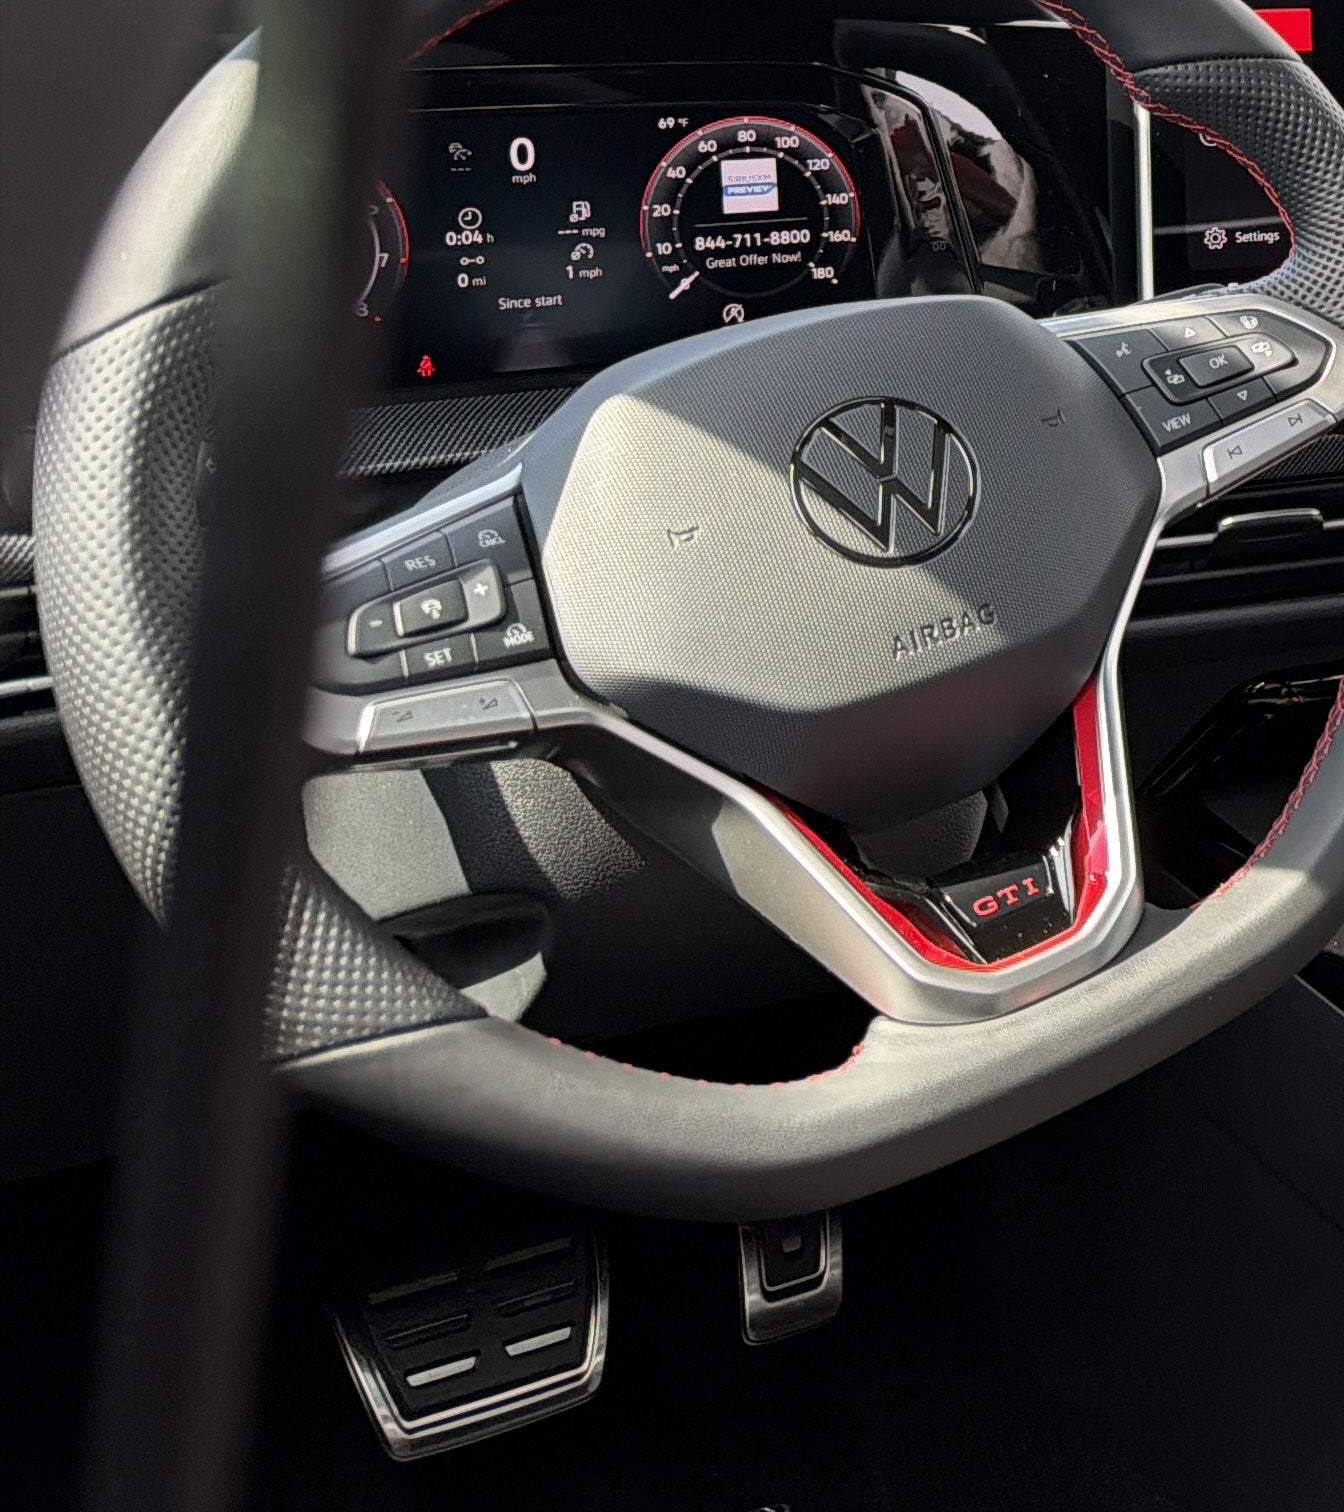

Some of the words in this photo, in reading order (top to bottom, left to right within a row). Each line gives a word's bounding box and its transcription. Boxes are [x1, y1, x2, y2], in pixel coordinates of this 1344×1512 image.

[657, 116, 675, 130] 69
[737, 130, 756, 142] 80
[775, 136, 799, 148] 100
[698, 140, 717, 152] 60
[510, 137, 535, 171] 0
[807, 158, 830, 171] 120
[512, 173, 537, 185] mph
[666, 166, 686, 179] 40
[727, 185, 772, 194] PREVIEW
[825, 192, 849, 205] 140
[652, 204, 671, 217] 20
[445, 230, 484, 246] 0:04
[486, 233, 495, 244] h
[581, 227, 606, 238] mpg
[828, 230, 851, 242] 160
[1235, 231, 1280, 245] Settings
[694, 229, 811, 251] 844-711-8800
[656, 242, 672, 255] 10
[706, 255, 736, 269] Great
[739, 253, 769, 266] Offer
[772, 251, 802, 264] Now!
[565, 265, 574, 280] 1
[579, 267, 603, 280] mph
[661, 263, 680, 273] mph
[811, 266, 835, 280] 180
[457, 273, 469, 288] 0
[472, 274, 487, 286] mi
[498, 296, 531, 310] Since
[535, 294, 563, 308] start
[1209, 354, 1228, 369] OK
[1162, 412, 1191, 432] VIEW
[404, 555, 436, 571] RES
[504, 630, 534, 648] MODE
[892, 603, 997, 661] AIRBAG
[424, 647, 452, 667] SET
[973, 878, 1039, 916] GTI
